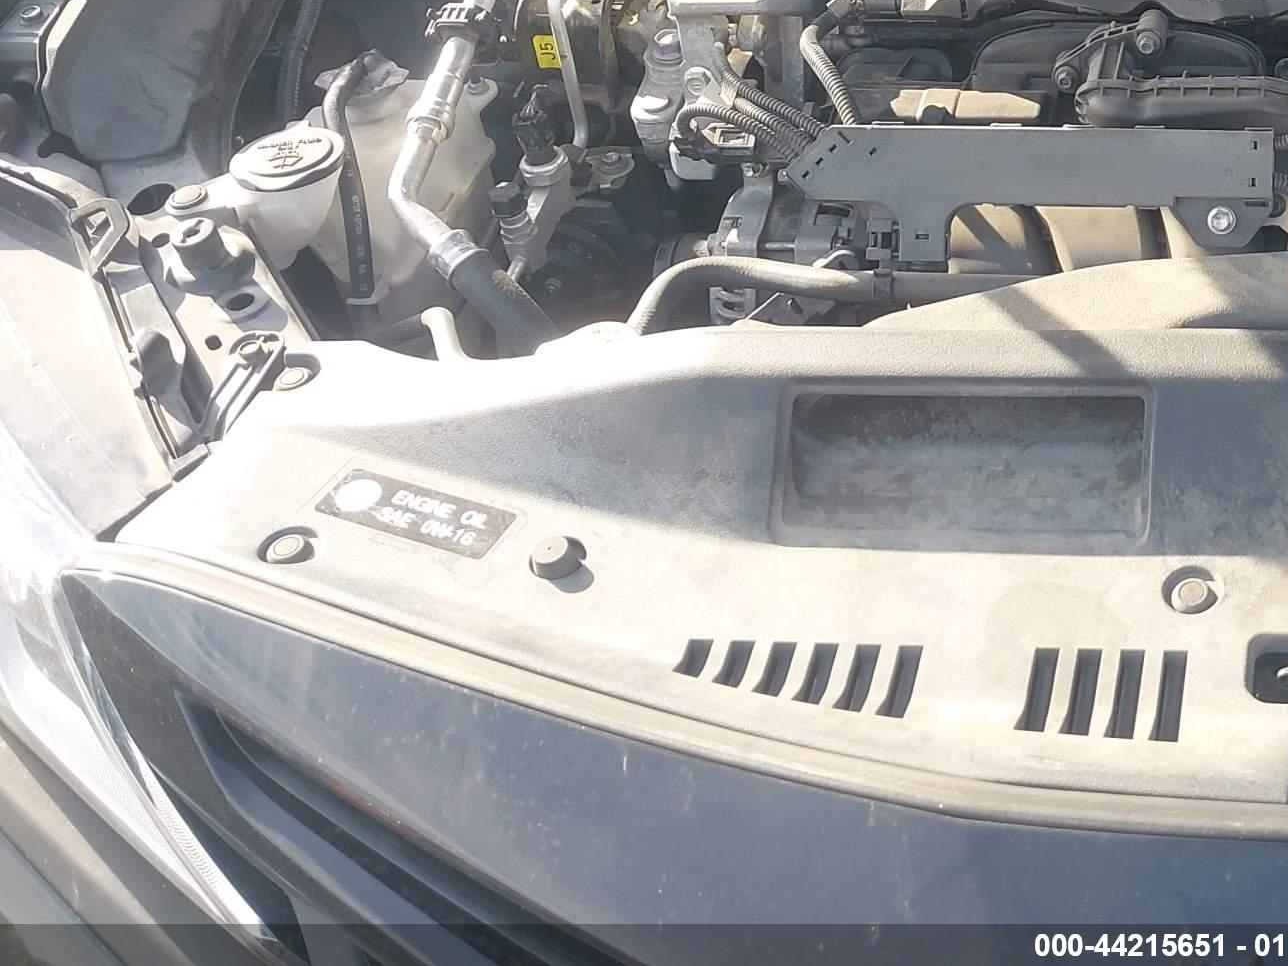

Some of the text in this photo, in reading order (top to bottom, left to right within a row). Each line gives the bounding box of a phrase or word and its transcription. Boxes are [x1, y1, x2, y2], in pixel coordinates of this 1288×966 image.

[539, 43, 556, 60] J5
[376, 507, 477, 546] SAE 0W-16
[391, 490, 488, 530] ENGINE OIL
